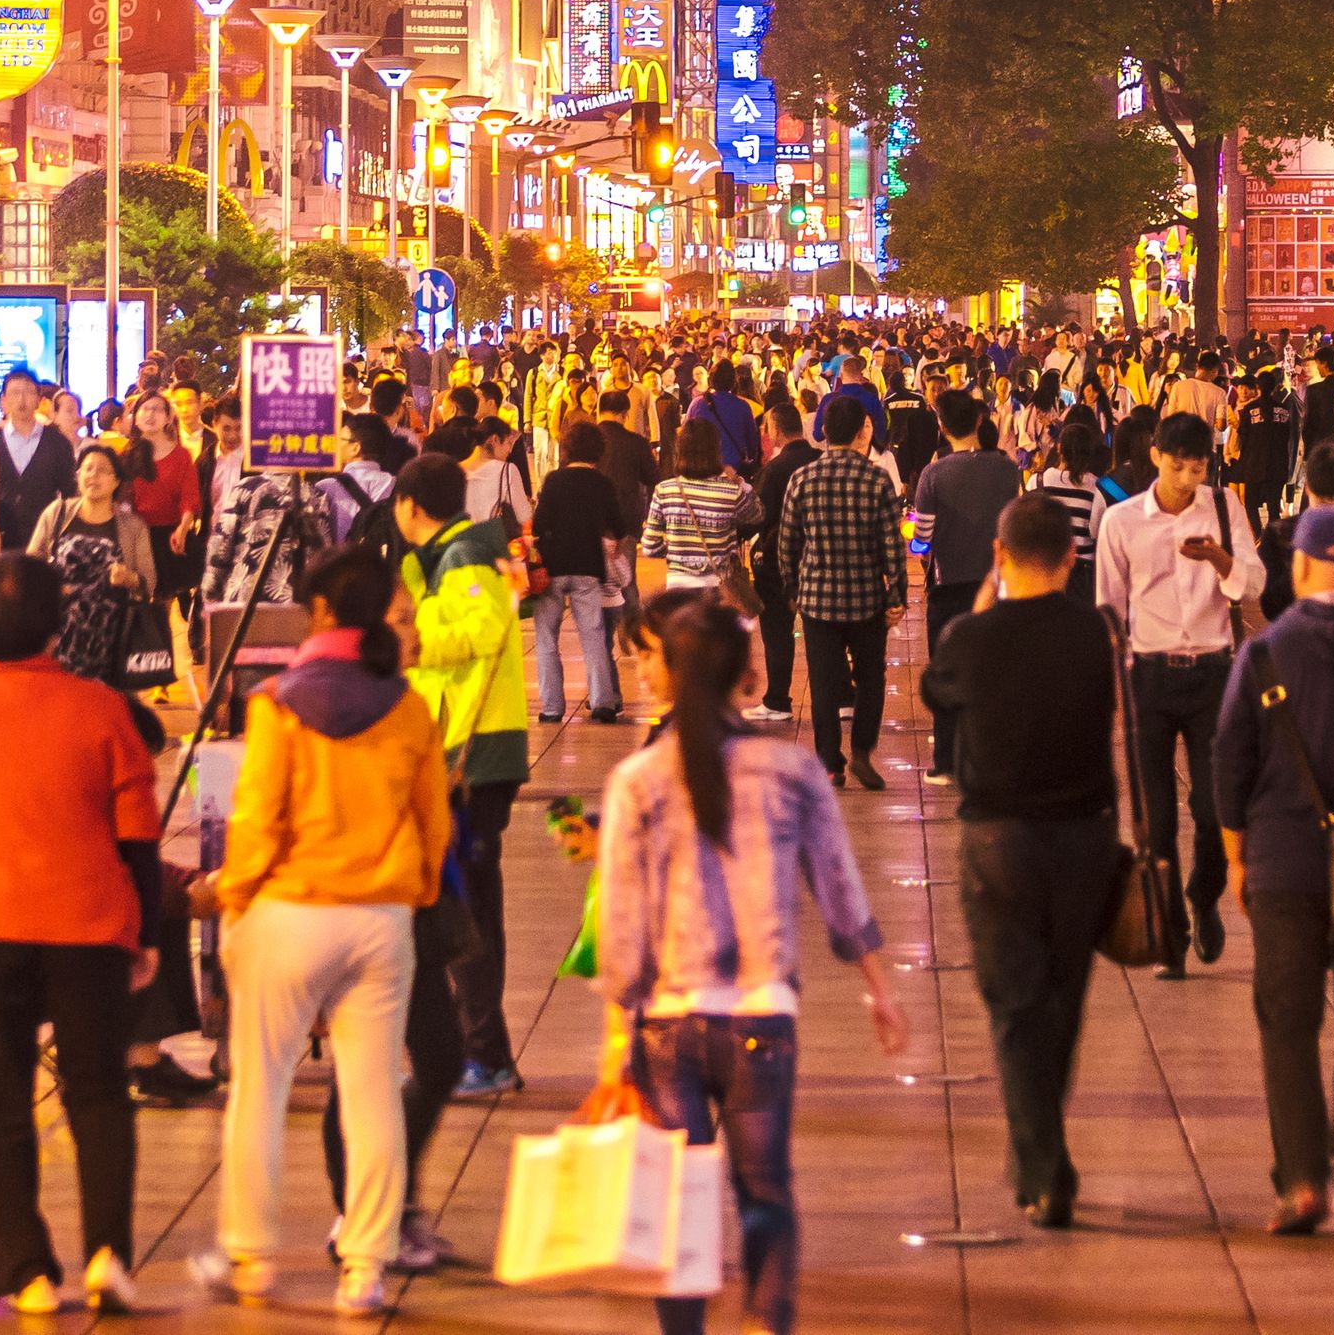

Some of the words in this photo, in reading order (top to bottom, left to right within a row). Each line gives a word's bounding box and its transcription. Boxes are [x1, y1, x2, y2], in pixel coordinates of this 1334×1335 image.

[577, 87, 635, 112] PHARMACY
[1246, 192, 1309, 205] HALLOWEEN
[252, 344, 337, 395] 快照
